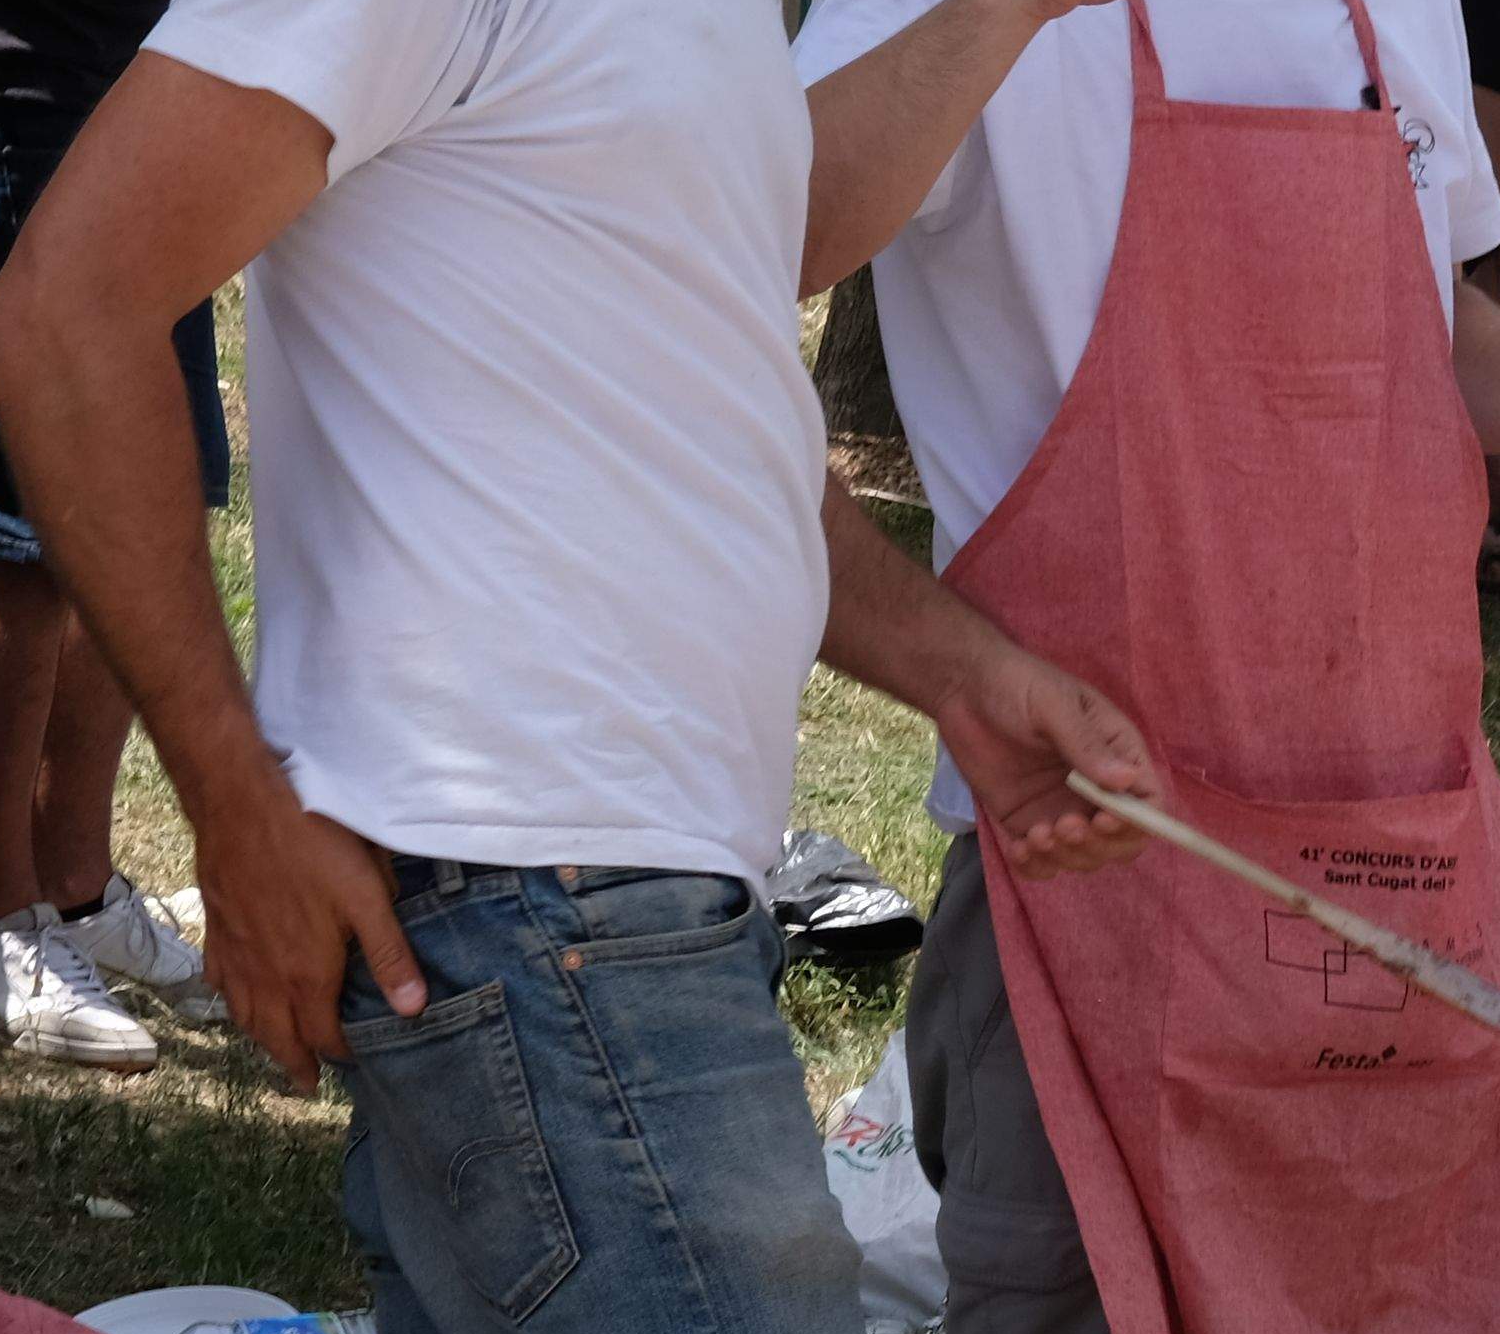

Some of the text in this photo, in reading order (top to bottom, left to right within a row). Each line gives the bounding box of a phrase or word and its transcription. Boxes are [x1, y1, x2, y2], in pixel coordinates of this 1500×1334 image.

[1330, 848, 1415, 870] CONCURS
[1324, 868, 1362, 886] Sant
[1367, 871, 1418, 892] Cugat
[1422, 876, 1447, 892] del
